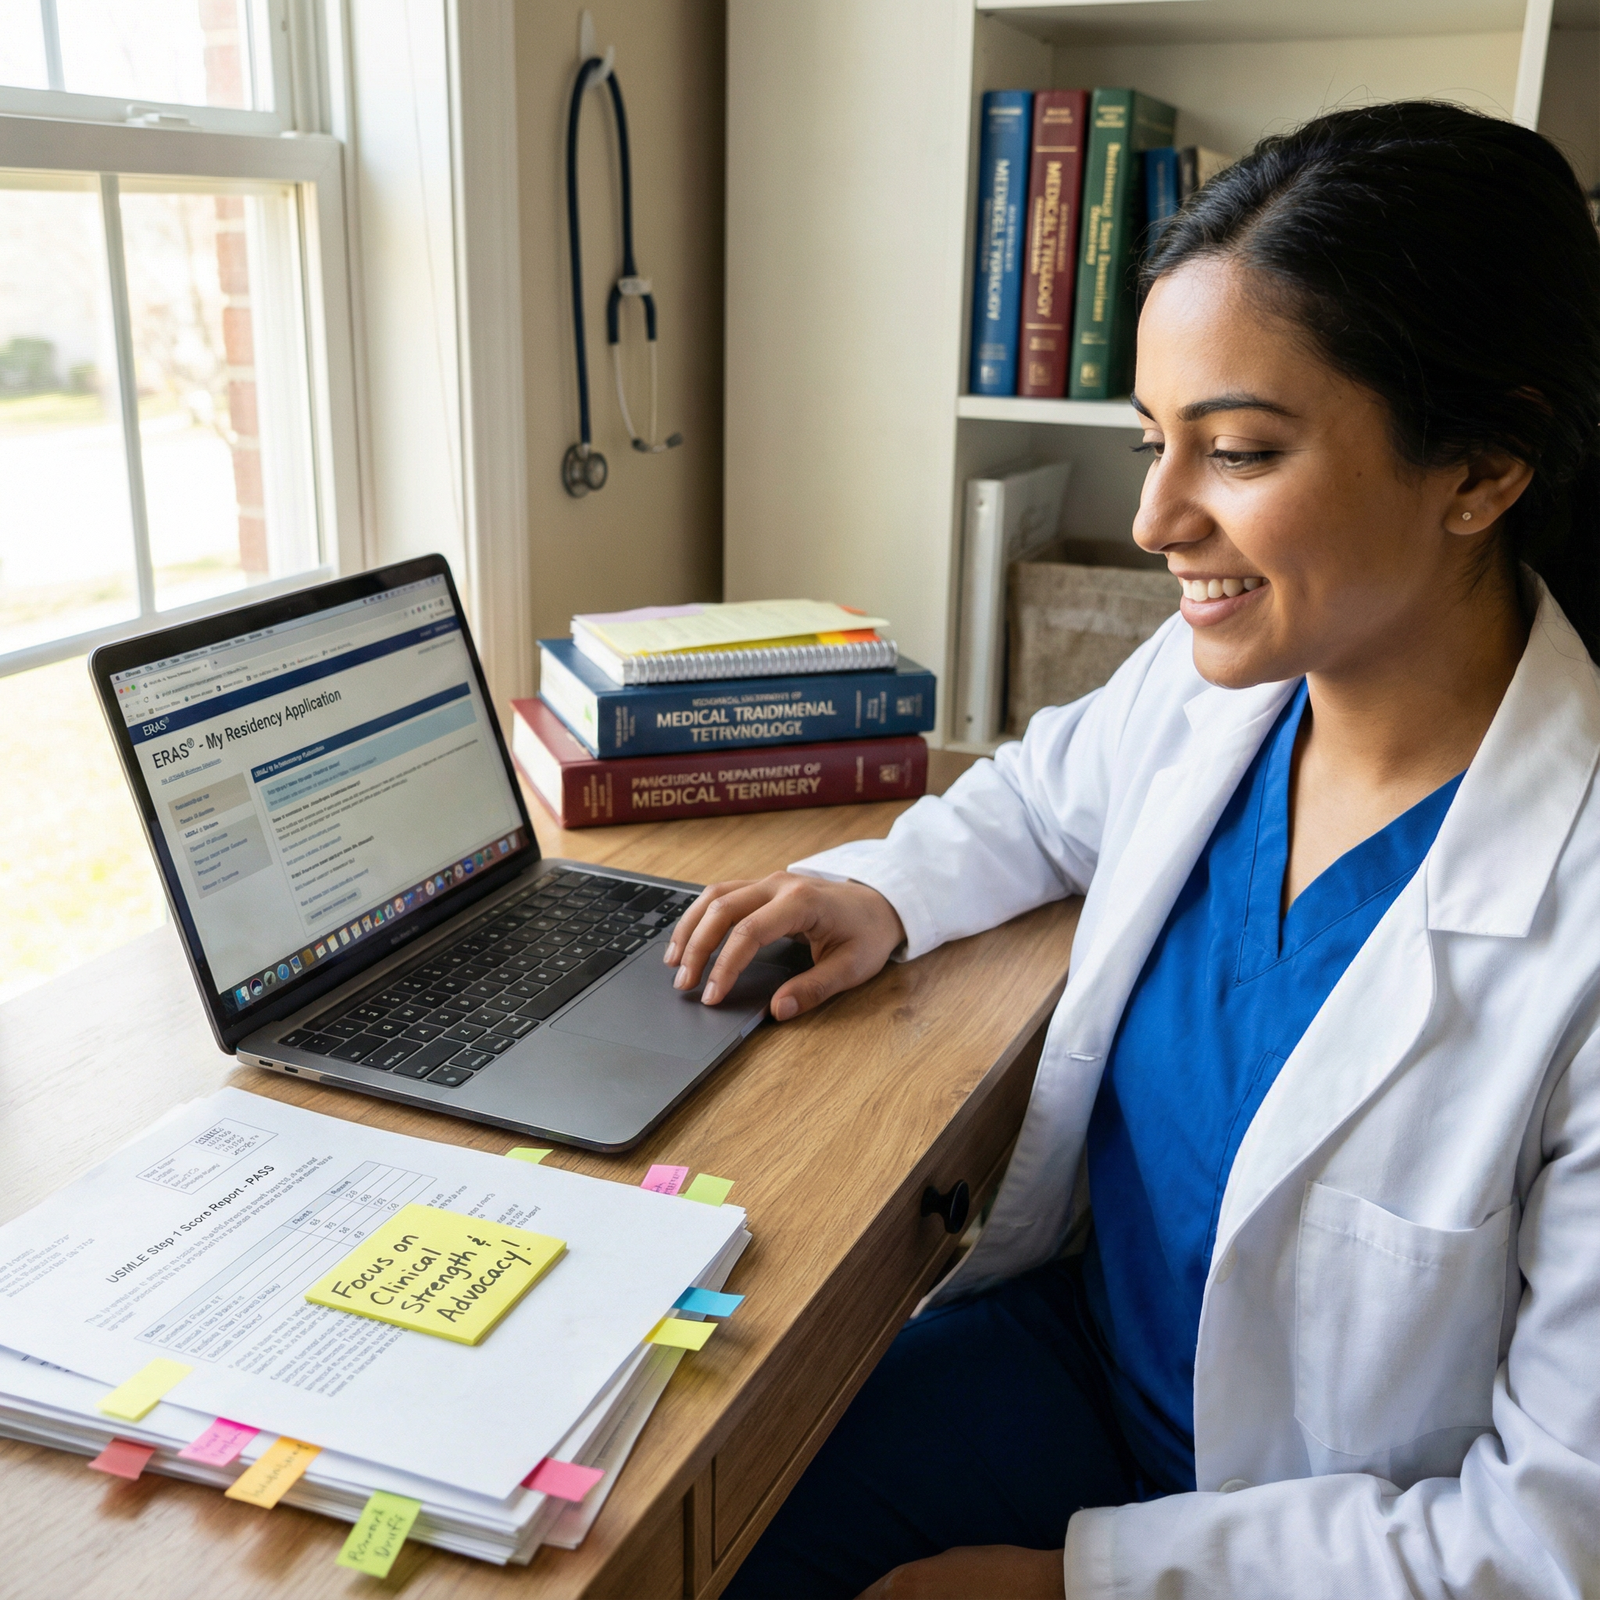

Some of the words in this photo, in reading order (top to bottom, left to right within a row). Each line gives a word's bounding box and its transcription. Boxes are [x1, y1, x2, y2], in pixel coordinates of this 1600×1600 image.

[205, 732, 224, 750] My
[225, 711, 283, 742] Residency
[285, 690, 342, 721] Application
[656, 709, 730, 728] MEDICAL
[632, 786, 721, 809] MEDICAL
[726, 777, 822, 801] TERIMERY
[718, 764, 801, 782] DEPARTMENT
[803, 762, 821, 775] OF
[105, 1253, 150, 1283] USMLE
[146, 1236, 175, 1256] Step
[208, 1187, 245, 1212] Report
[245, 1164, 275, 1186] PASS
[331, 1256, 394, 1298] Focus
[393, 1234, 419, 1253] on
[370, 1247, 442, 1305] Clinical
[401, 1250, 478, 1314] Strength
[437, 1239, 532, 1323] Advocacy!
